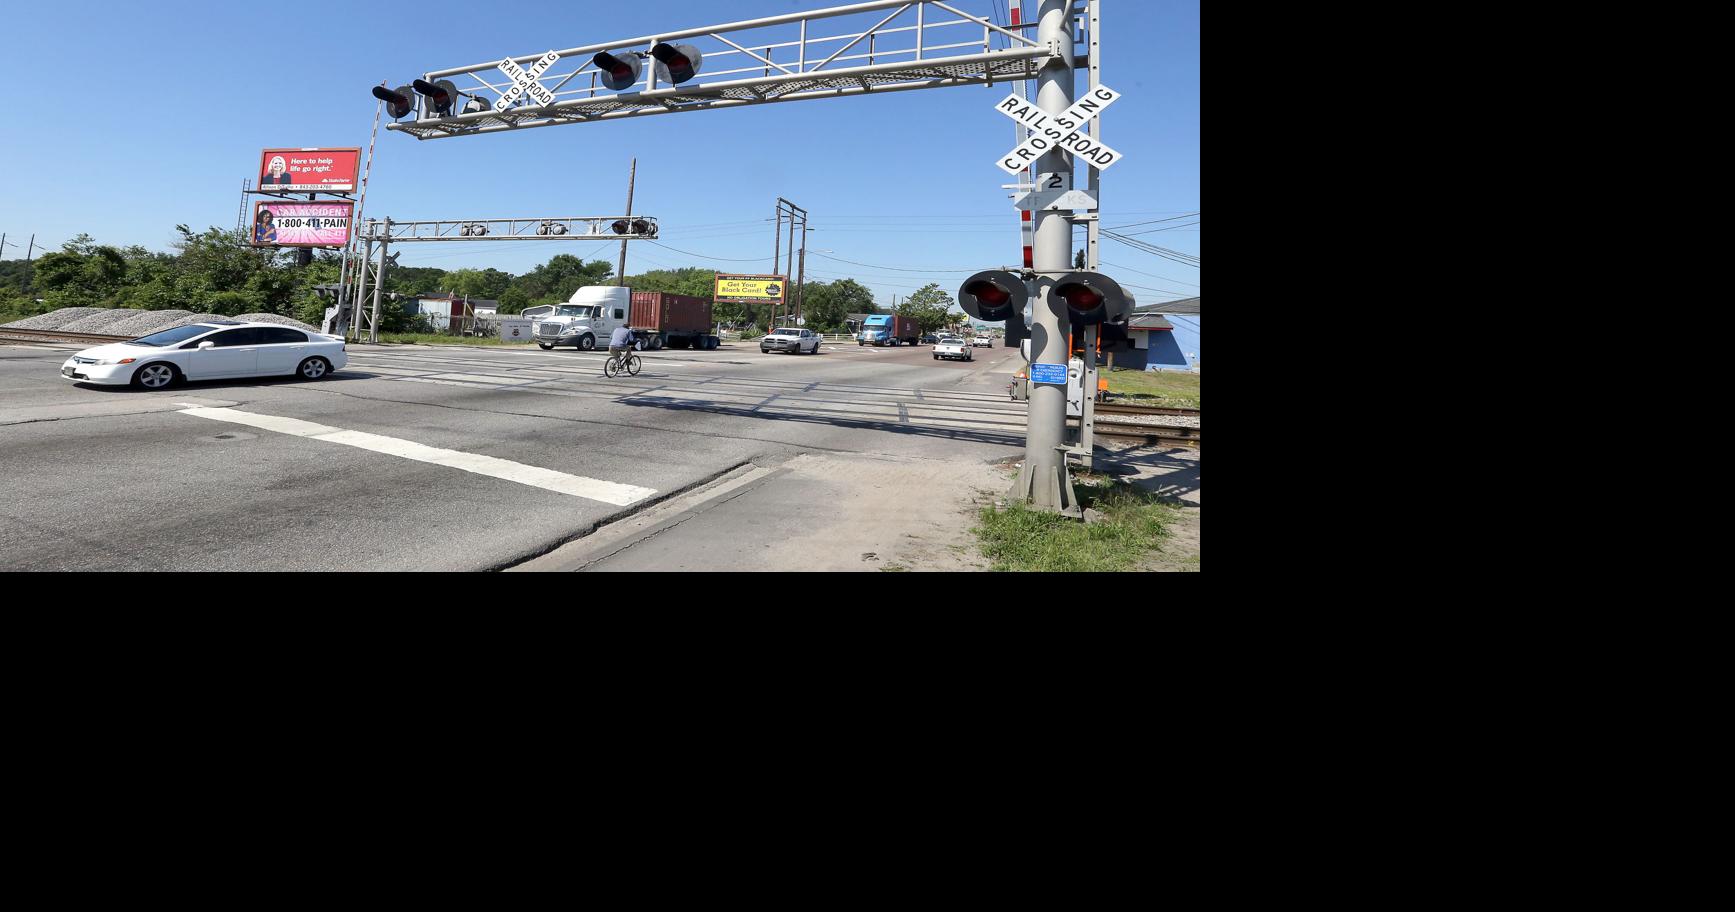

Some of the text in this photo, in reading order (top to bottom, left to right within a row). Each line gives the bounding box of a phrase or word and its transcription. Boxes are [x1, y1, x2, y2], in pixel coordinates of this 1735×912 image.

[496, 53, 556, 109] CROSSING
[1004, 89, 1113, 170] CROSSING
[1048, 176, 1063, 188] 2
[277, 208, 348, 216] CAR ACCIDENT
